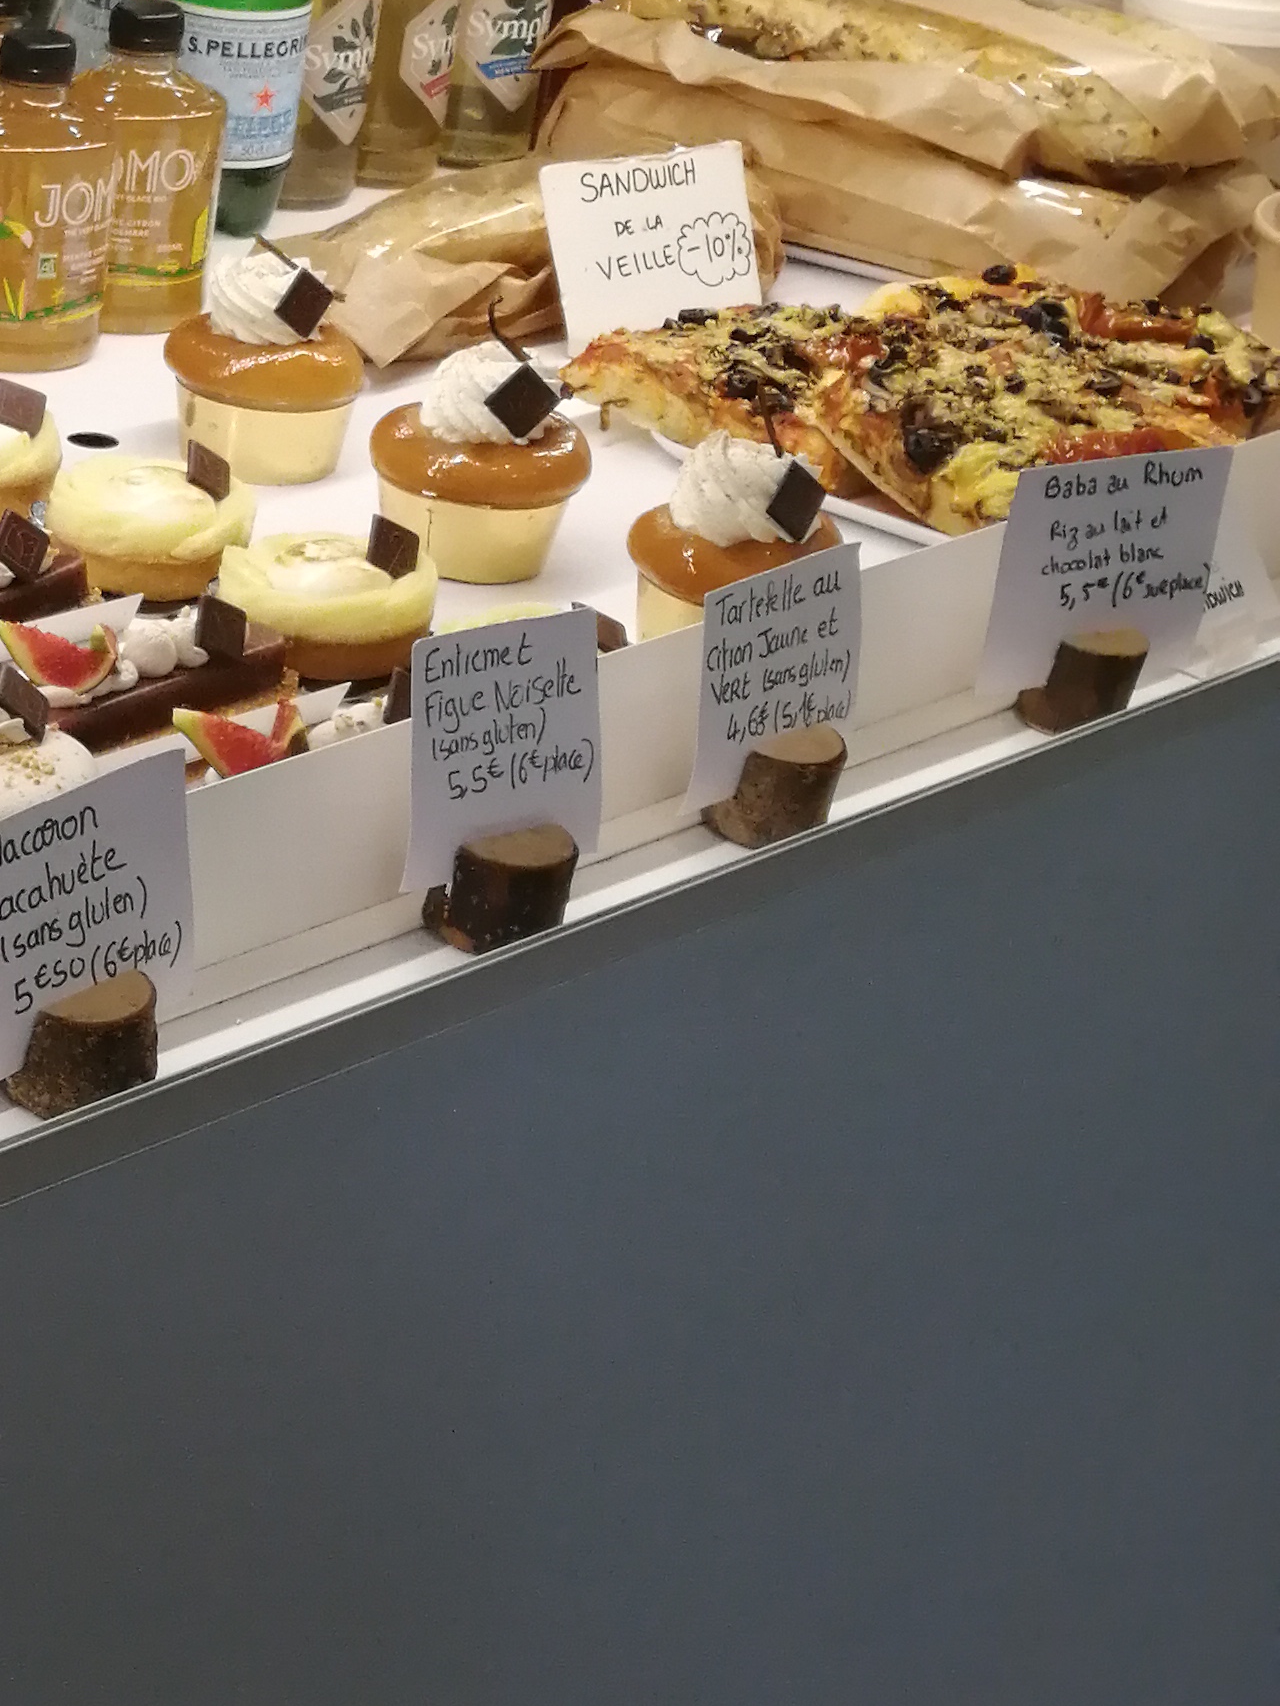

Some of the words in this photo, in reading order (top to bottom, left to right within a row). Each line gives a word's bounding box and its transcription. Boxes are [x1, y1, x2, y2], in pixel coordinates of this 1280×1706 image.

[580, 158, 697, 204] SANDWICH
[614, 219, 633, 238] DE
[645, 214, 664, 232] LA
[596, 244, 676, 281] VEILLE
[686, 228, 744, 264] -10%
[1043, 472, 1099, 500] Baba
[1106, 472, 1131, 495] au
[1142, 458, 1204, 489] Rhum
[1084, 521, 1107, 540] au
[1113, 509, 1143, 533] lait
[1149, 505, 1169, 530] et
[812, 569, 843, 597] au
[756, 626, 809, 658] Jaune
[817, 606, 840, 638] et
[424, 689, 486, 735] Figue
[493, 656, 582, 714] Noisette
